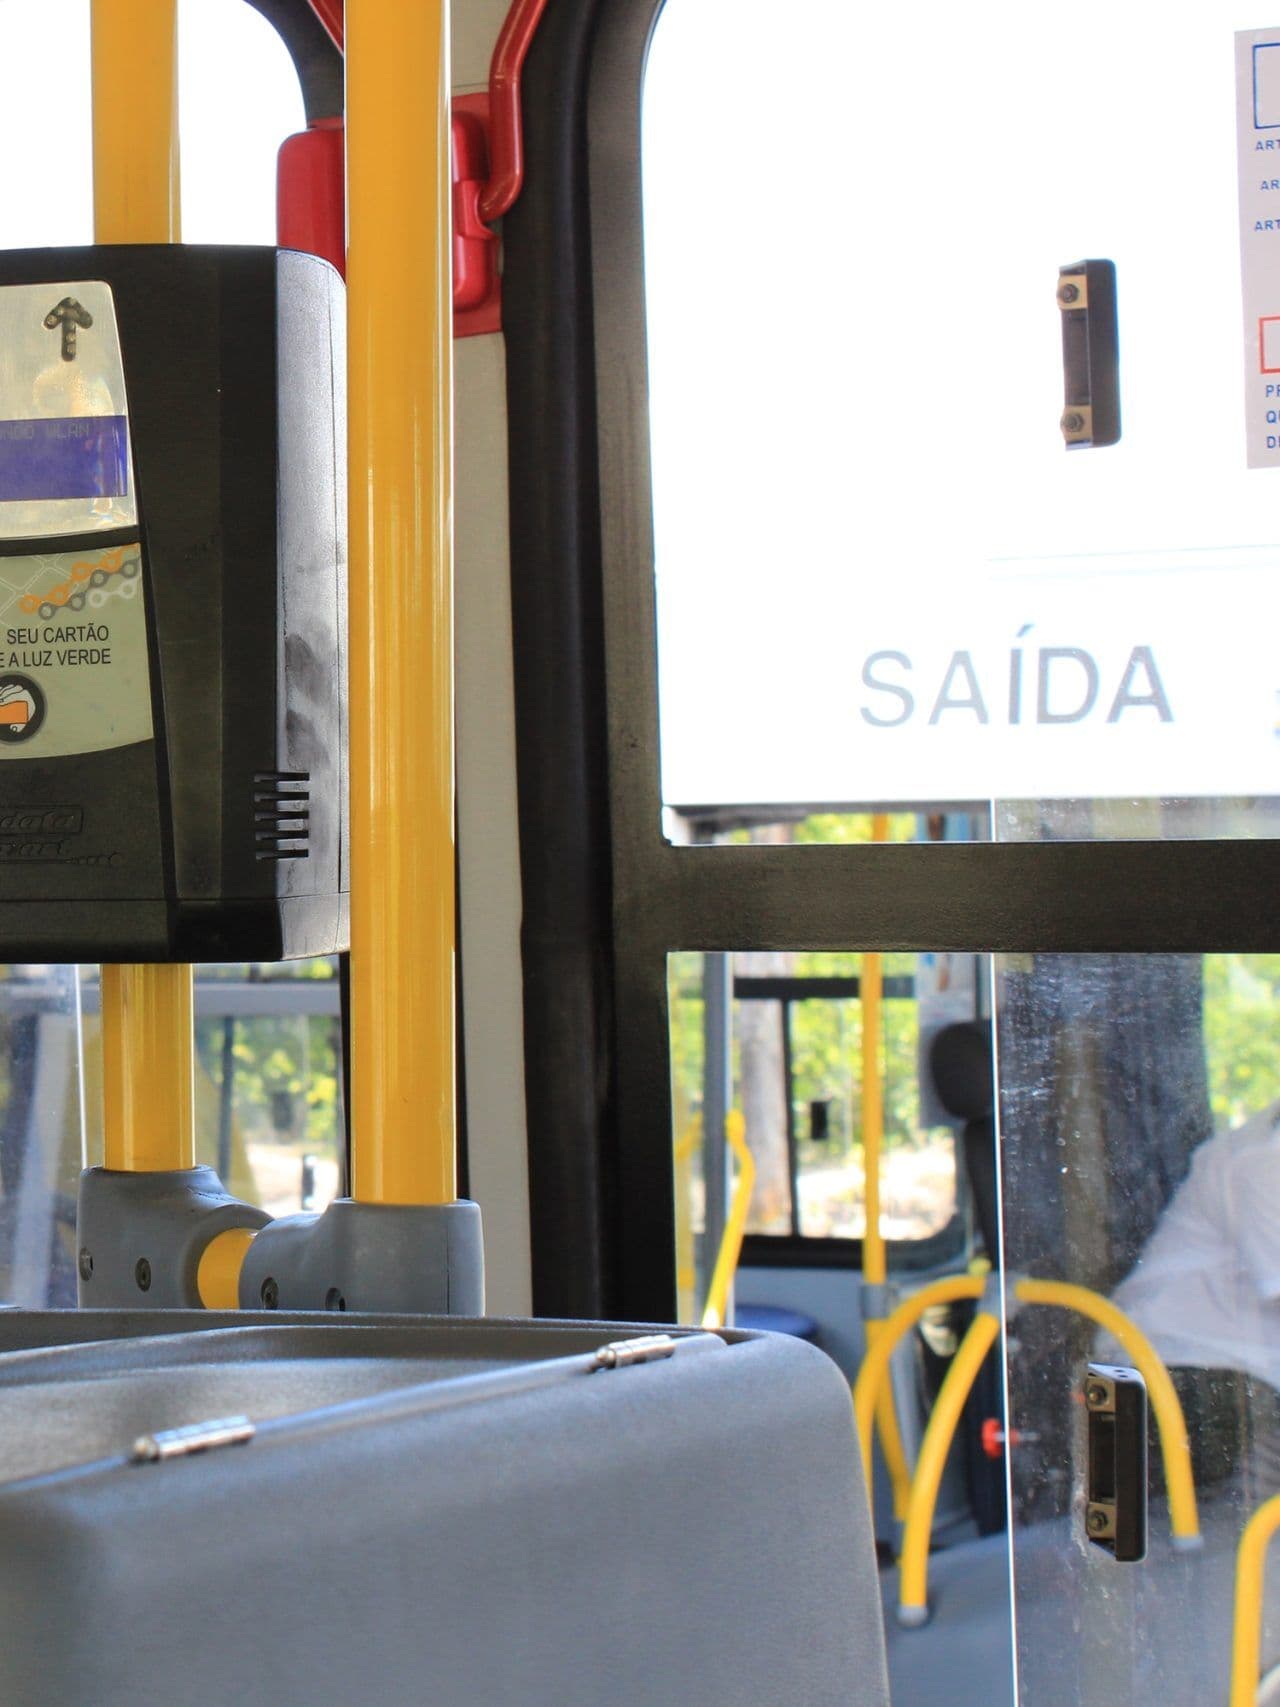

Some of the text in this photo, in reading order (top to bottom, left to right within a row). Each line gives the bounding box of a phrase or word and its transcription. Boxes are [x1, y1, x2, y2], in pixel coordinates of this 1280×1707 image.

[45, 423, 90, 440] WLAN
[6, 627, 39, 645] SEU
[43, 622, 109, 643] CARTÃO
[8, 651, 19, 668] A
[23, 650, 53, 667] LUZ
[57, 648, 111, 666] VERDE
[859, 623, 1175, 727] SAÍDA
